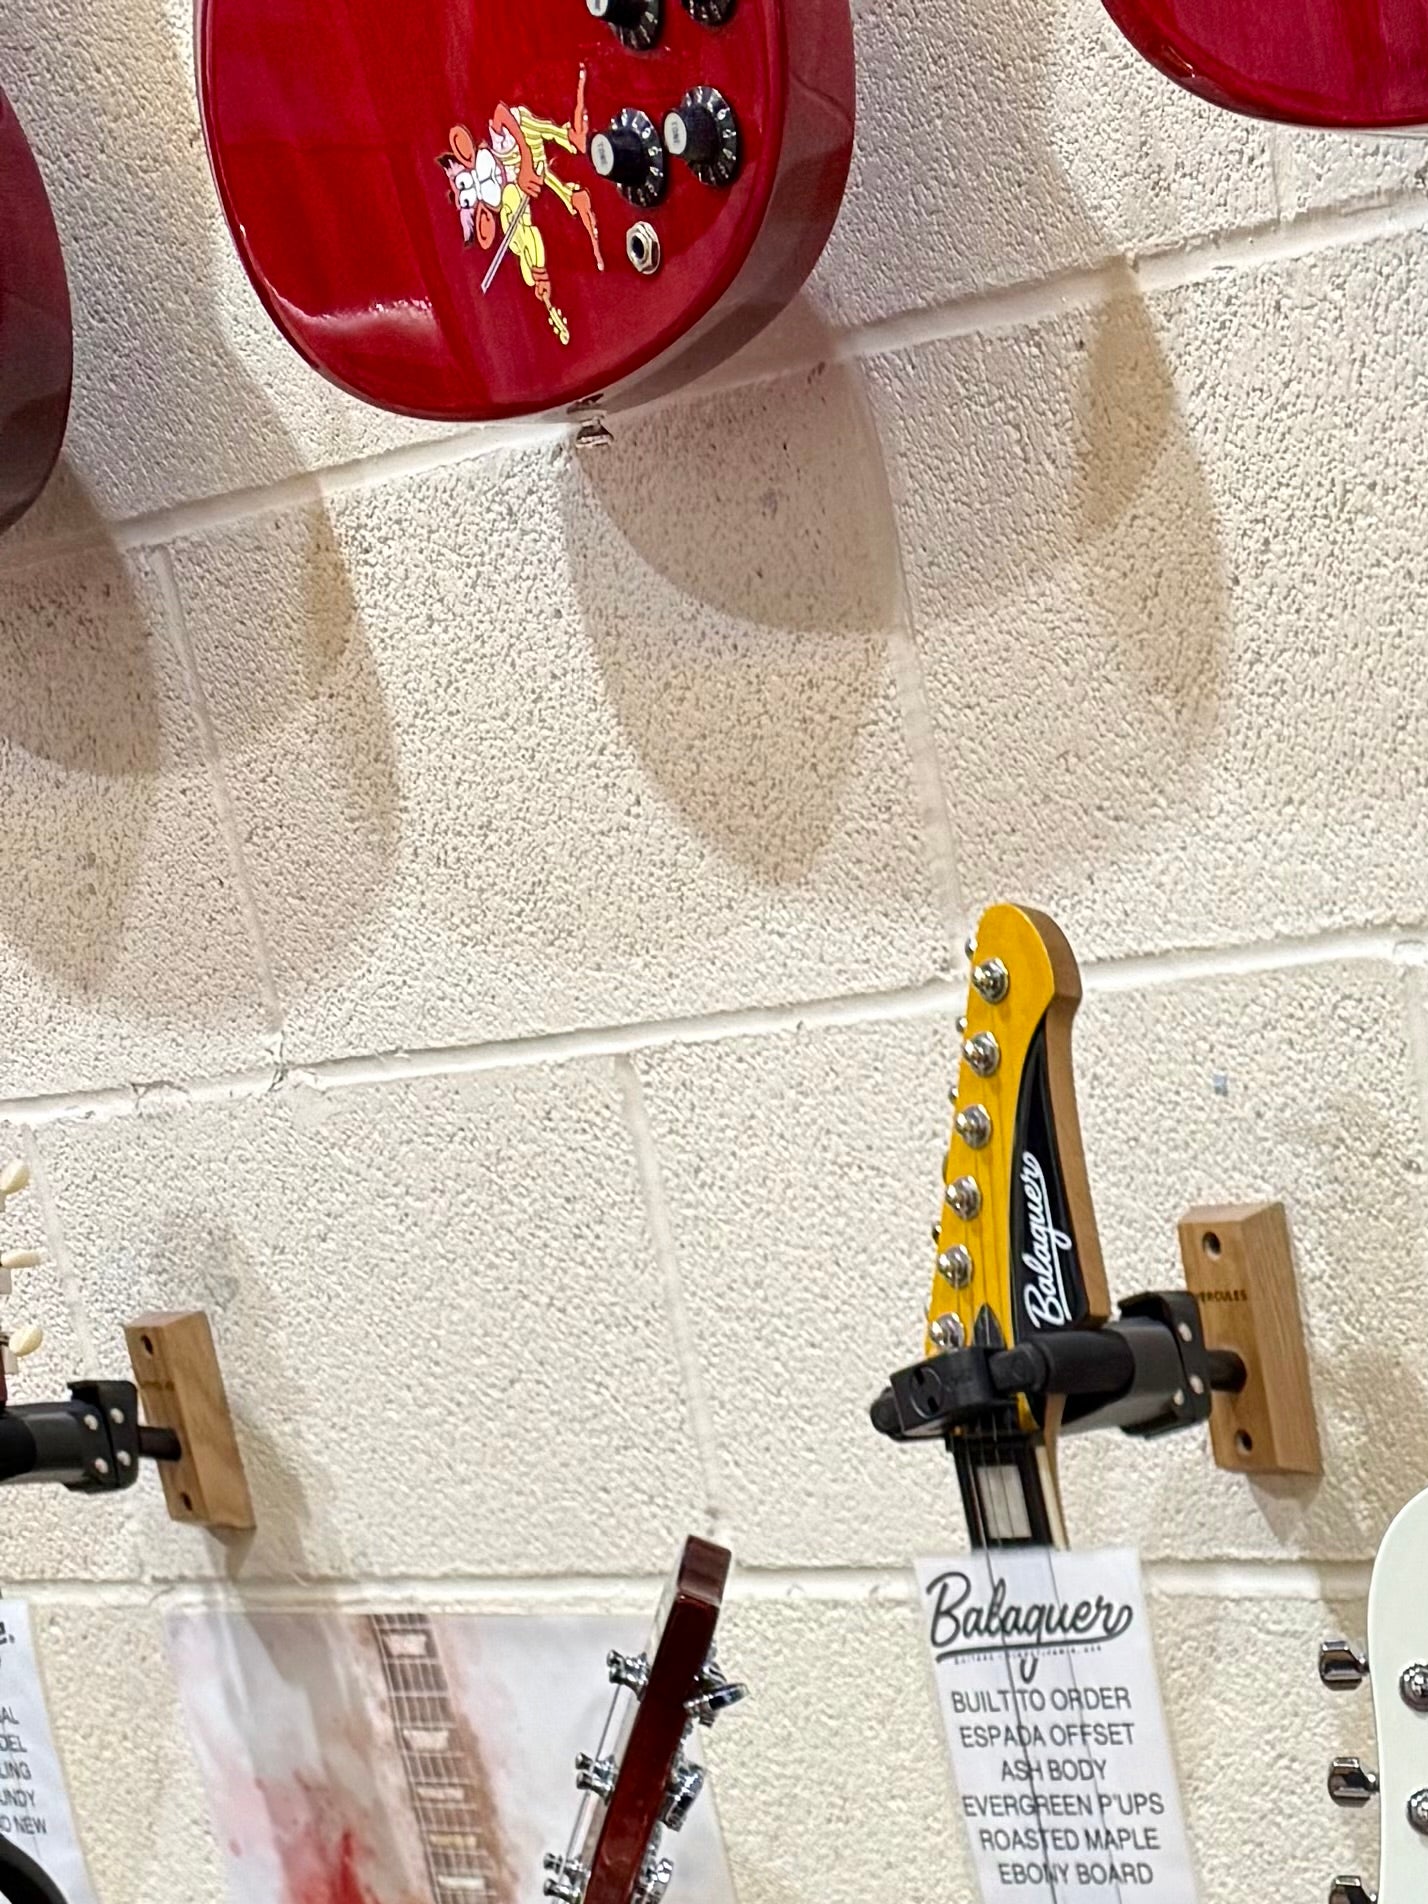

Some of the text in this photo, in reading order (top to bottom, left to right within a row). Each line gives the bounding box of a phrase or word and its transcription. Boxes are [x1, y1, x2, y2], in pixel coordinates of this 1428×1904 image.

[1022, 1151, 1073, 1329] Balaguer
[926, 1571, 1133, 1684] Balaguer
[951, 1687, 1131, 1714] BUILT TO ORDER
[960, 1723, 1134, 1748] ESPADA OFFSET
[1002, 1759, 1107, 1782] ASH BODY
[963, 1795, 1093, 1816] EVERGREEN
[14, 1816, 47, 1835] NEW
[980, 1827, 1160, 1851] ROASTED MAPLE
[998, 1862, 1153, 1885] EBONY BOARD
